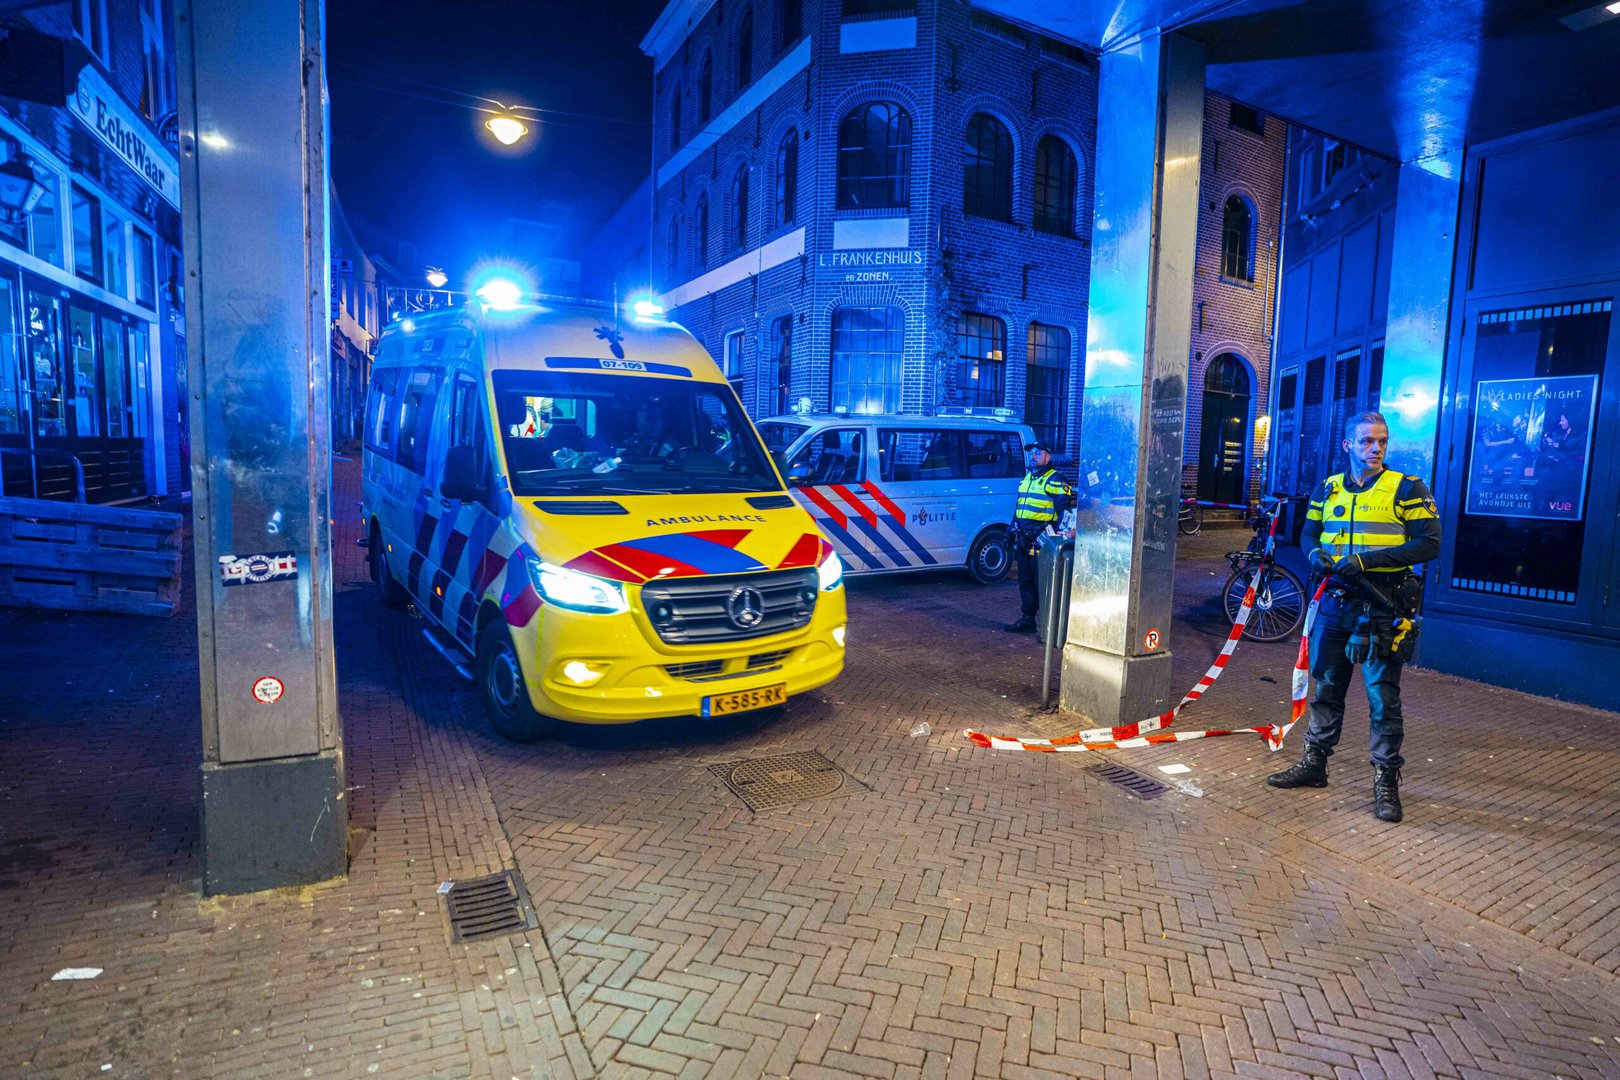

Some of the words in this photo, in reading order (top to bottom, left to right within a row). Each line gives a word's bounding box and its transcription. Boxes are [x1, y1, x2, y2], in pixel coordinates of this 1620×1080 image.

[95, 95, 165, 191] EchtWaar
[845, 274, 855, 282] en
[602, 360, 643, 371] 07-109
[1501, 391, 1539, 401] LADIES
[1544, 389, 1582, 400] NIGHT
[1479, 490, 1493, 499] HET
[1495, 492, 1528, 501] LEUKSTE
[1478, 499, 1514, 508] AVONDJE
[1517, 501, 1532, 509] UIT
[646, 515, 767, 527] AMBULANCE
[714, 687, 784, 713] K-585-RK
